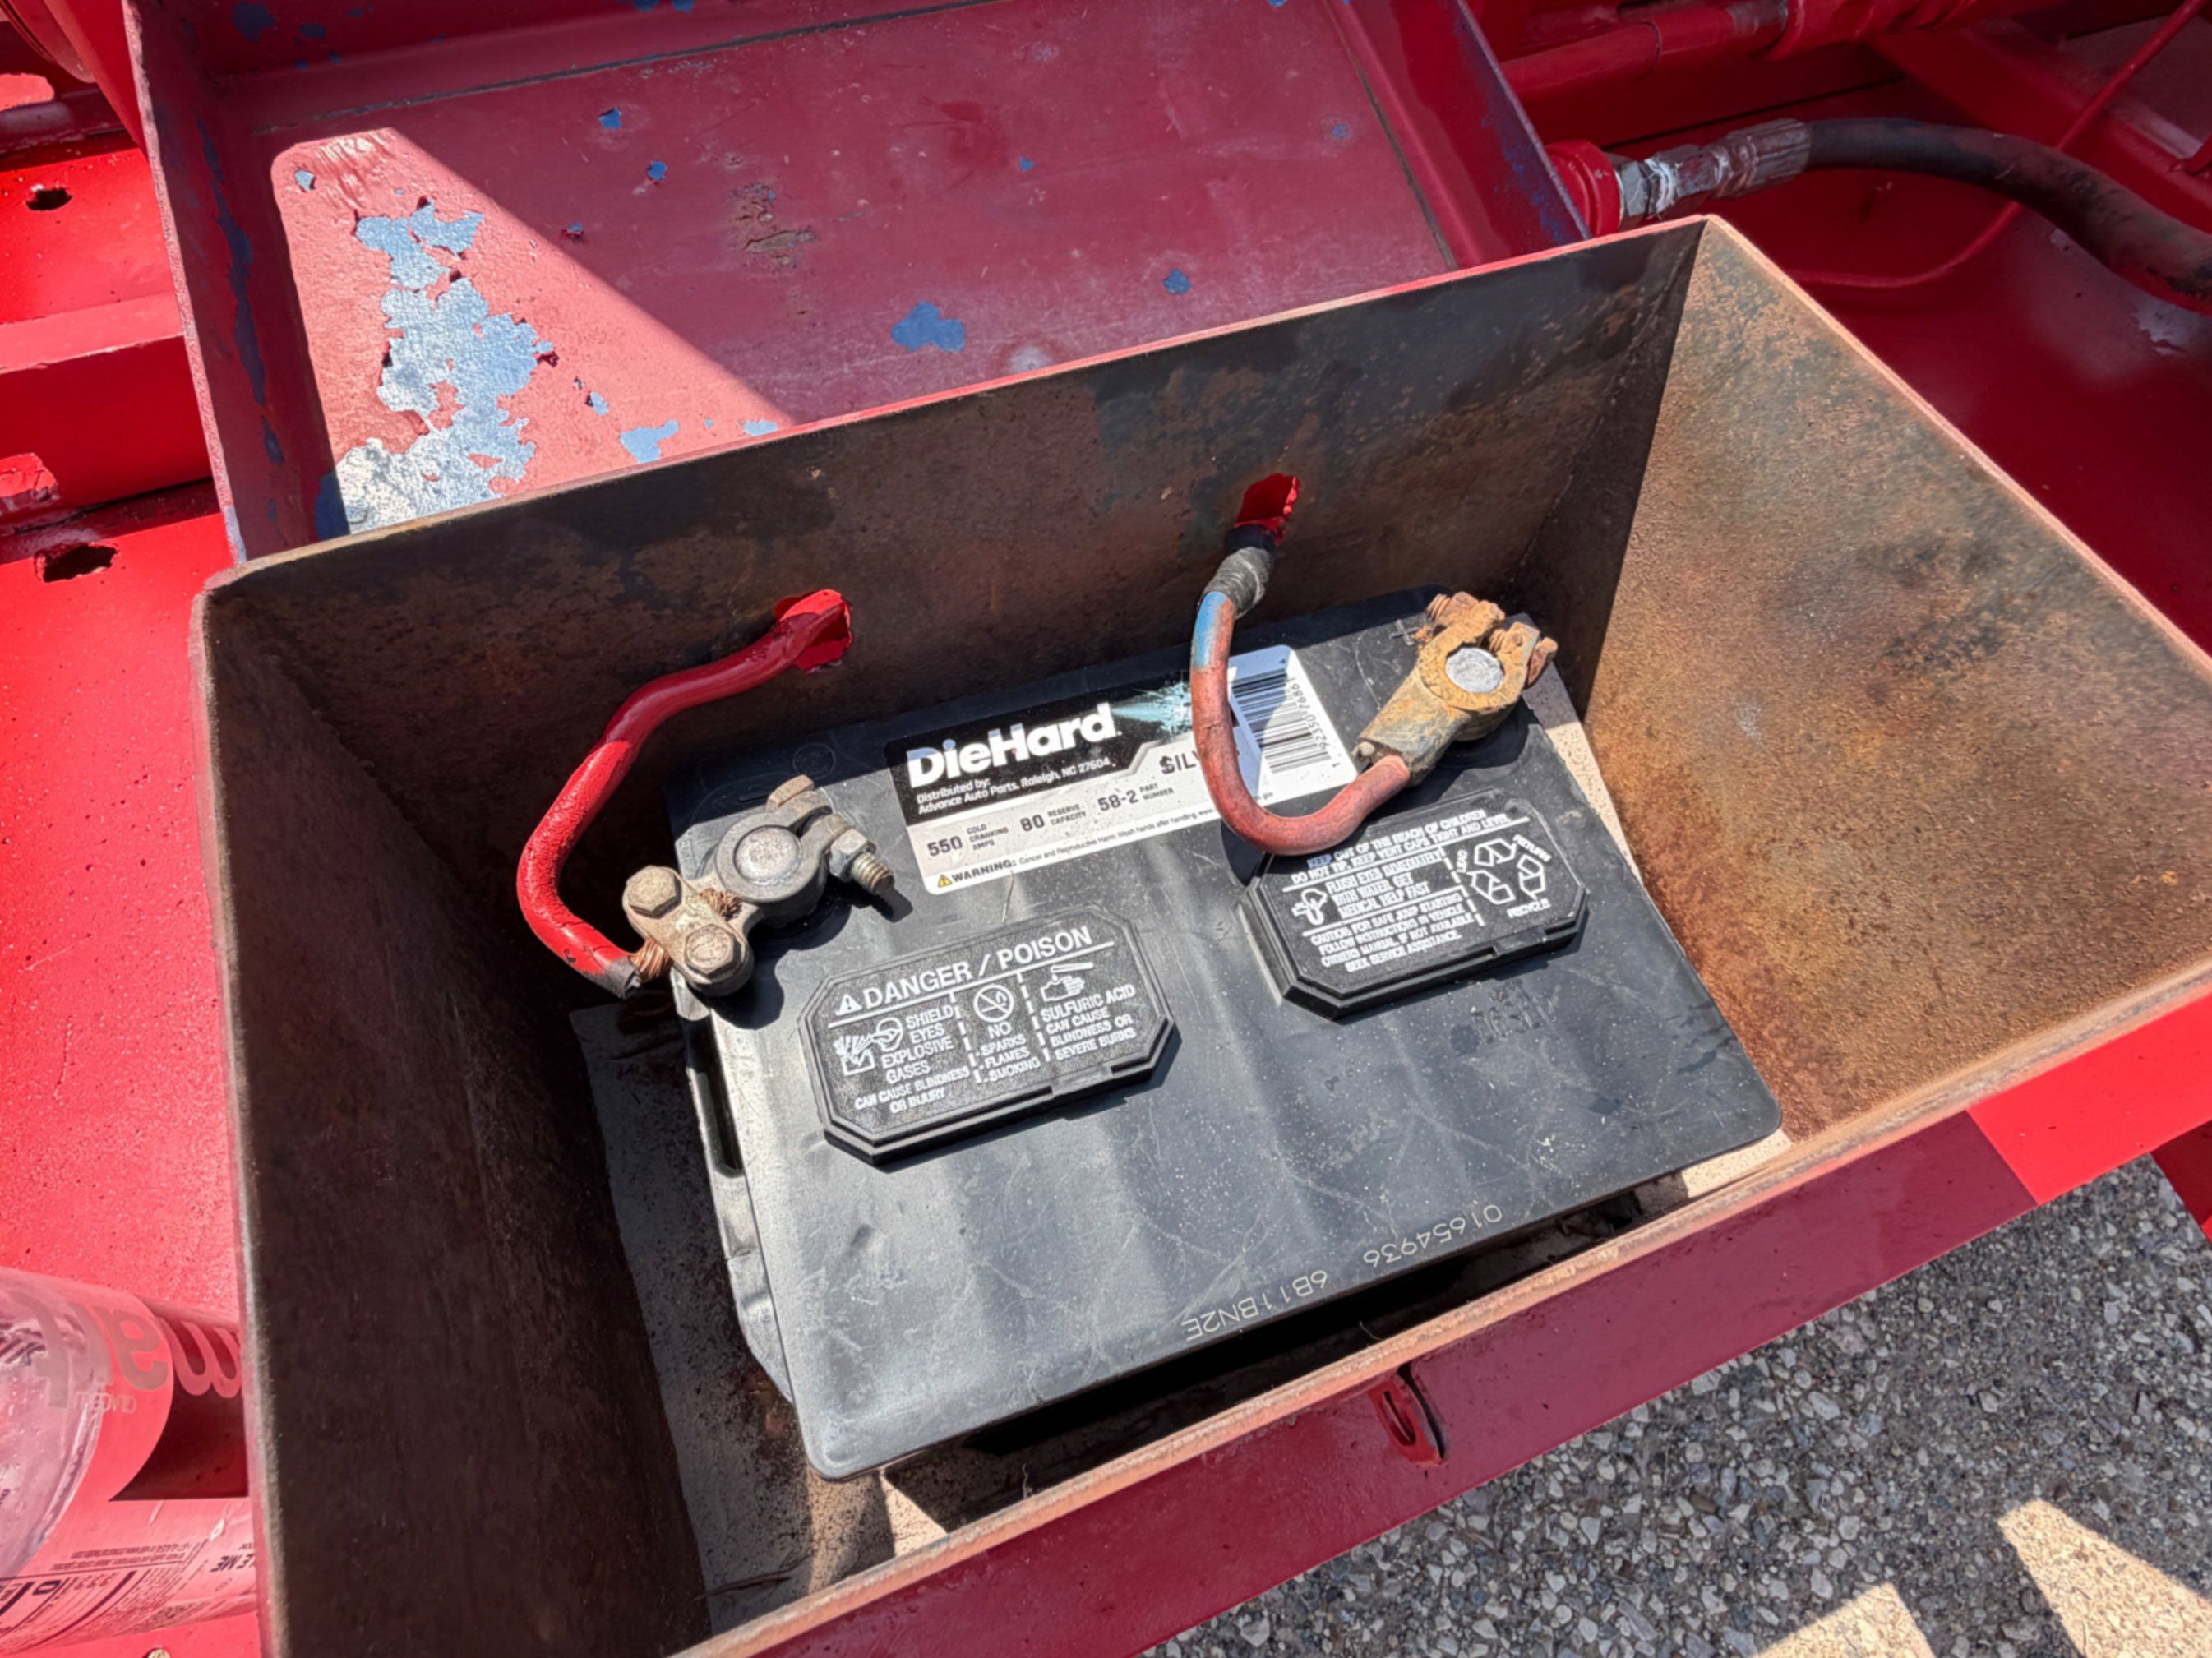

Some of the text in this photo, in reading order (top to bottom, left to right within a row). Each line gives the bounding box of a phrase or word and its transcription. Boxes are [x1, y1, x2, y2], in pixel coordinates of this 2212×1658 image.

[907, 702, 1117, 788] DieHard
[1303, 713, 1331, 750] 92350
[915, 776, 991, 803] Distributed by:
[917, 795, 963, 815] Advance
[962, 788, 988, 802] Auto
[1060, 765, 1077, 776] NC
[1077, 756, 1111, 773] 27604
[1138, 782, 1158, 792] PART
[1142, 786, 1174, 801] NUMBER
[1046, 802, 1080, 818] RESERVE
[1097, 788, 1139, 811] 58-2
[966, 823, 987, 834] COLD
[1018, 813, 1046, 832] 80
[1049, 810, 1087, 826] CAPACITY
[926, 834, 963, 857] 550
[968, 826, 1009, 843] CRANKING
[972, 838, 995, 851] AMPS
[1306, 807, 1487, 869] KEEP OUT OF THE REACH OF CHILDREN
[1513, 834, 1551, 862] RETURN
[950, 857, 1017, 883] WARNING:
[1018, 852, 1042, 864] Cancer
[1043, 849, 1055, 857] and
[1055, 838, 1098, 856] Reproductive
[1117, 828, 1135, 838] Wash
[1135, 822, 1155, 833] hands
[1155, 819, 1170, 827] after
[1291, 871, 1309, 884] DO
[1307, 865, 1331, 880] NOT
[1351, 851, 1378, 867] KEEP
[1376, 843, 1404, 860] VENT
[1402, 834, 1431, 852] CAPS
[1429, 826, 1459, 843] TIGHT
[1459, 820, 1481, 835] AND
[1457, 849, 1467, 872] LEAD
[1324, 849, 1443, 894] FLUSH EYES IMMEDIATELY
[1330, 888, 1359, 907] WITH
[1392, 871, 1415, 889] GET
[1337, 880, 1430, 919] MEDICAL HELP FAST
[1350, 919, 1373, 934] FOR
[1371, 912, 1396, 927] SAFE
[1393, 905, 1420, 921] JUMP
[1418, 891, 1463, 913] STARTING
[1507, 898, 1551, 918] RECYCLE
[1318, 903, 1466, 956] FOLLOW INSTRUCTIONS IN VEHICLE
[1397, 932, 1410, 944] IF
[1408, 926, 1429, 940] NOT
[861, 958, 973, 1009] DANGER
[996, 924, 1094, 971] POISON
[1344, 956, 1371, 972] SEEK
[1368, 944, 1407, 965] SERVICE
[904, 1003, 955, 1029] SHIELD
[1039, 982, 1137, 1023] SULFURIC ACID
[908, 1022, 946, 1044] EYES
[986, 1019, 1013, 1039] NO
[1044, 1005, 1110, 1035] CAN CAUSE
[1049, 1013, 1134, 1048] BLINDNESS OR
[880, 1034, 954, 1069] EXPLOSIVE
[980, 1033, 1027, 1056] SPARKS
[1054, 1026, 1137, 1061] SEVERE BURNS
[984, 1046, 1031, 1069] FLAMES
[987, 1055, 1041, 1082] SMOKING
[884, 1059, 931, 1085] GASES
[854, 1065, 971, 1111] CAN CAUSE BLINDNESS
[888, 1087, 947, 1114] OR INJURY
[1181, 1203, 1503, 1342] 01654936 6B11BN2E
